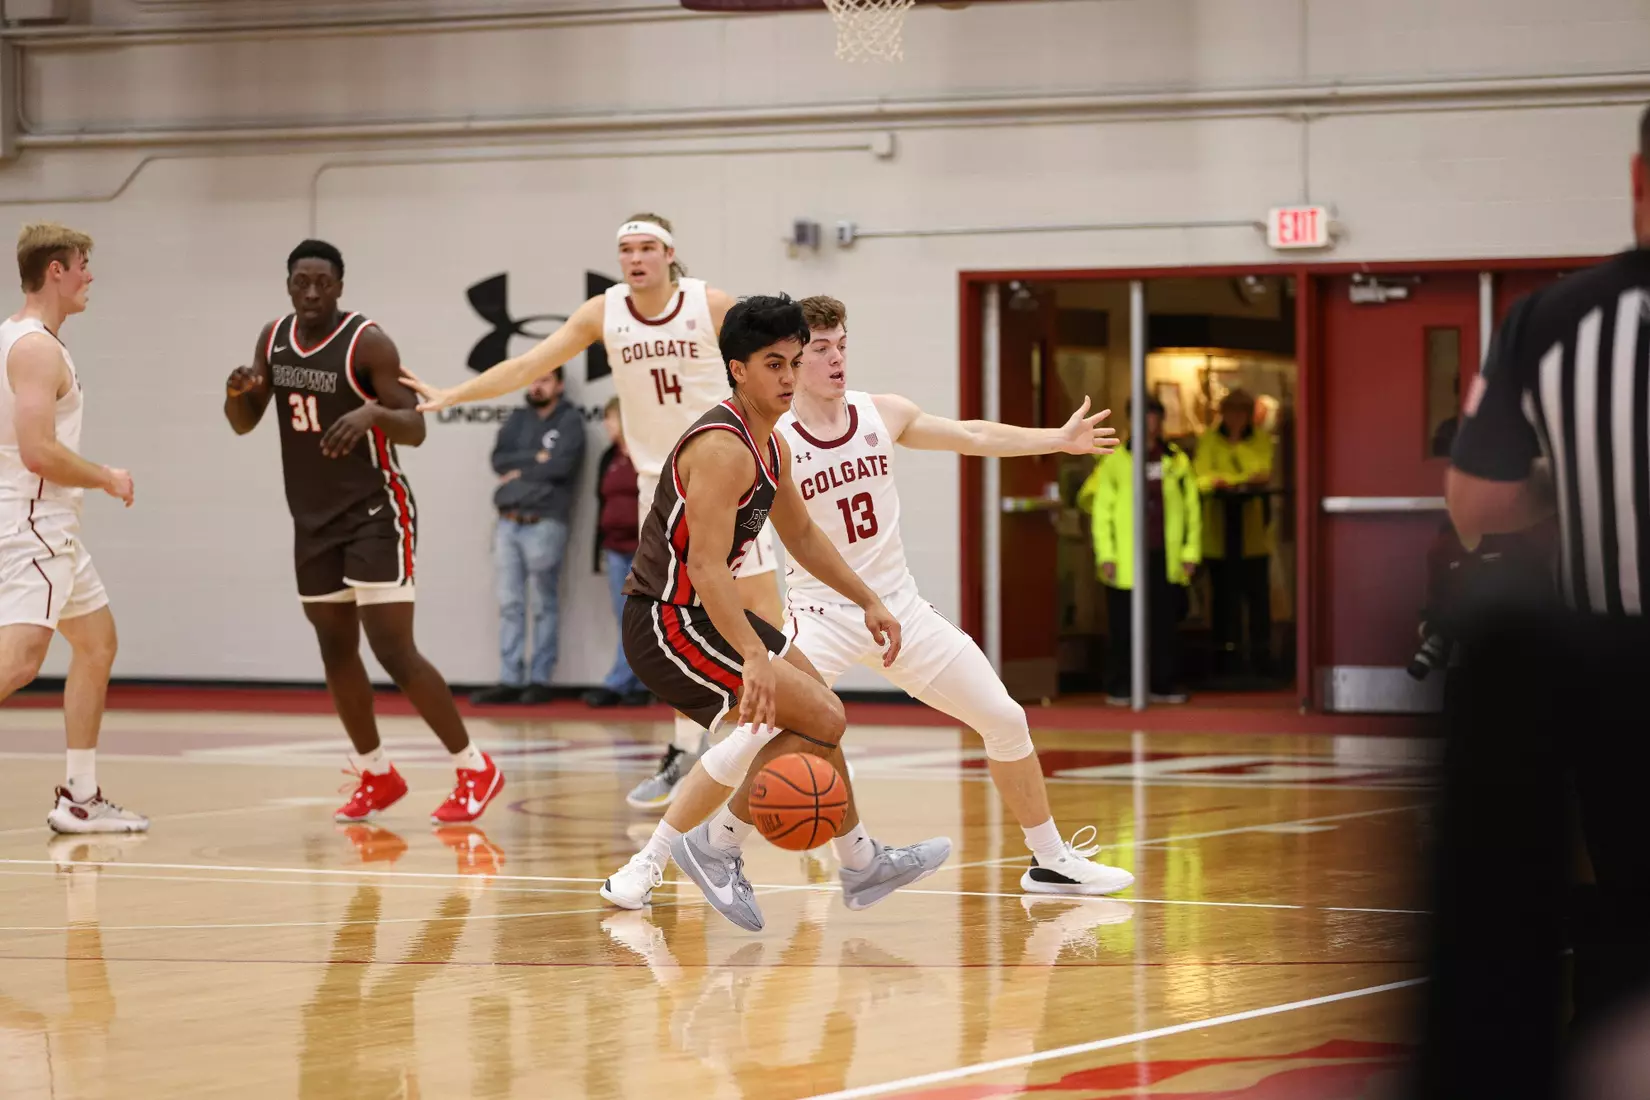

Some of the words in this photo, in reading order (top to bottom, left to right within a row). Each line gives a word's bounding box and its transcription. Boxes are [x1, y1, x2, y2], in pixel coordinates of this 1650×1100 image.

[1278, 209, 1318, 244] EXIT
[622, 340, 699, 364] COLGATE
[272, 364, 338, 393] BROWN
[650, 368, 682, 405] 14
[288, 392, 322, 432] 31
[801, 455, 888, 501] COLGATE
[836, 491, 878, 544] 13
